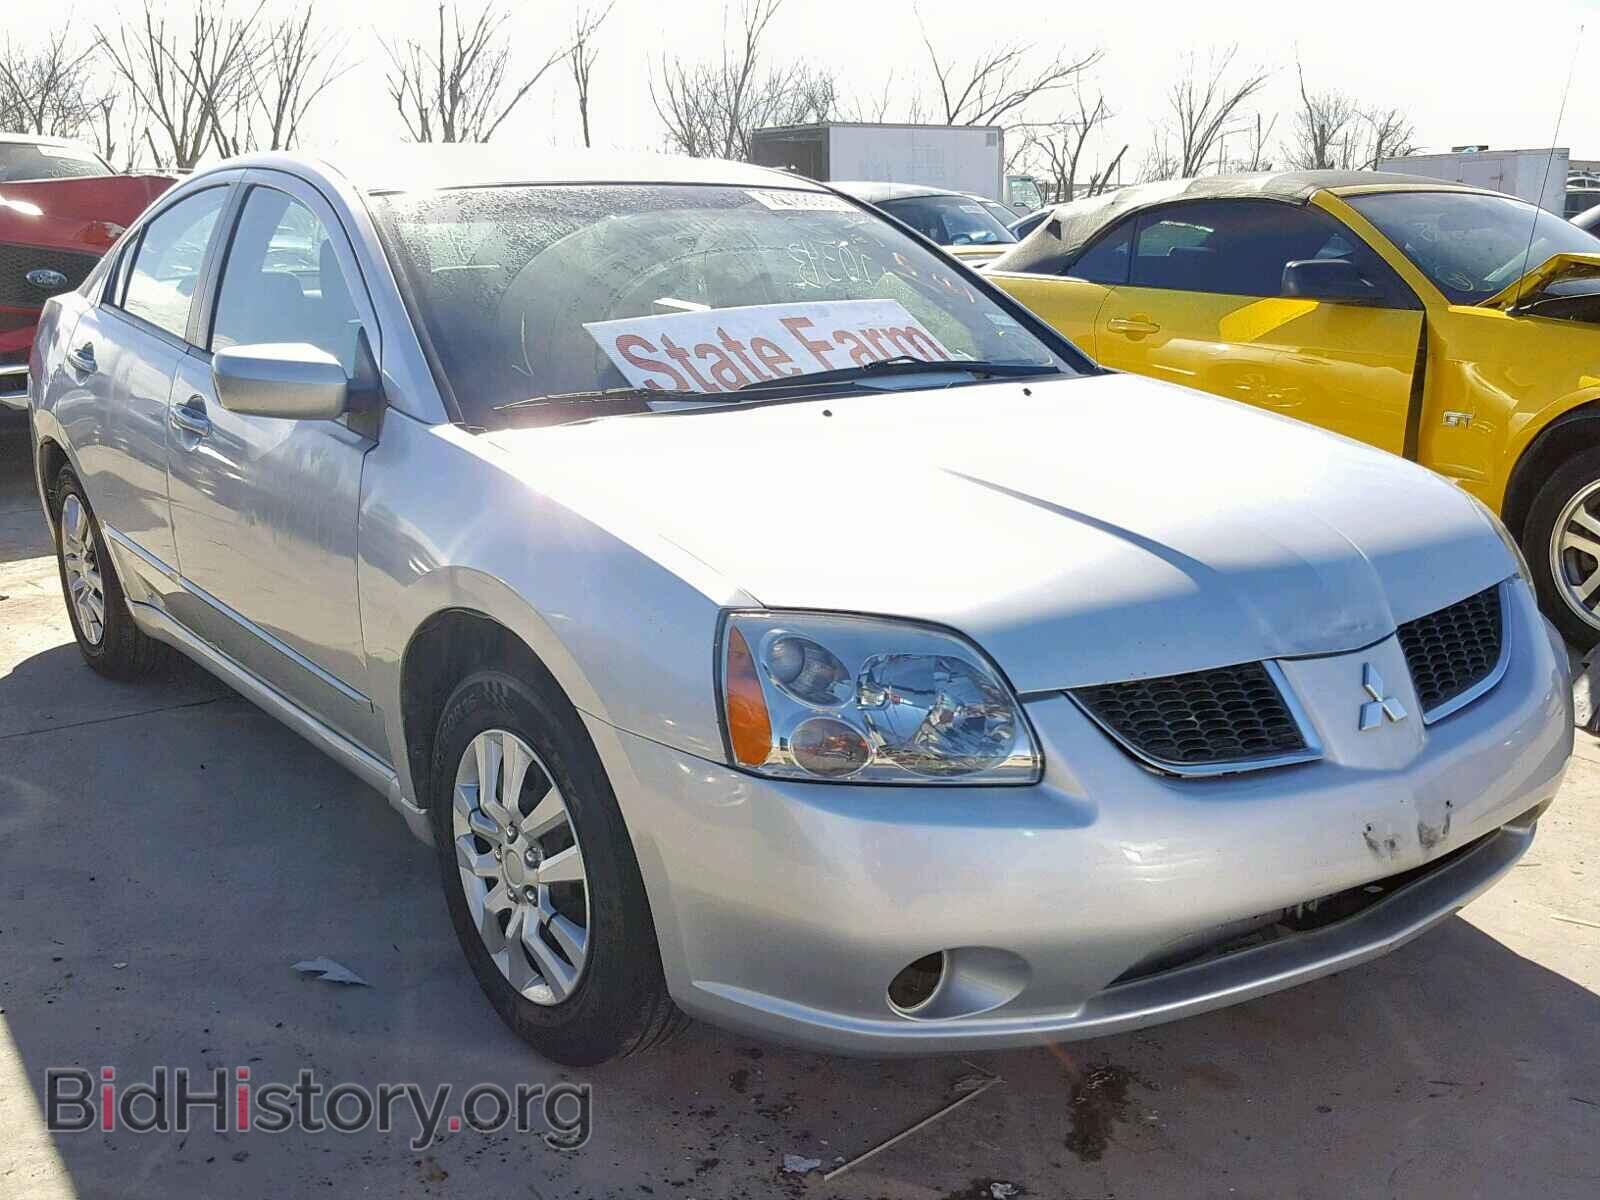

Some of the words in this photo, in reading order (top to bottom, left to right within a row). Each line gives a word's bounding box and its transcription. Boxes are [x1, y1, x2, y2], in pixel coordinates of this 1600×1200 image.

[616, 327, 801, 392] State
[779, 317, 951, 369] Farm
[1443, 410, 1473, 429] GT
